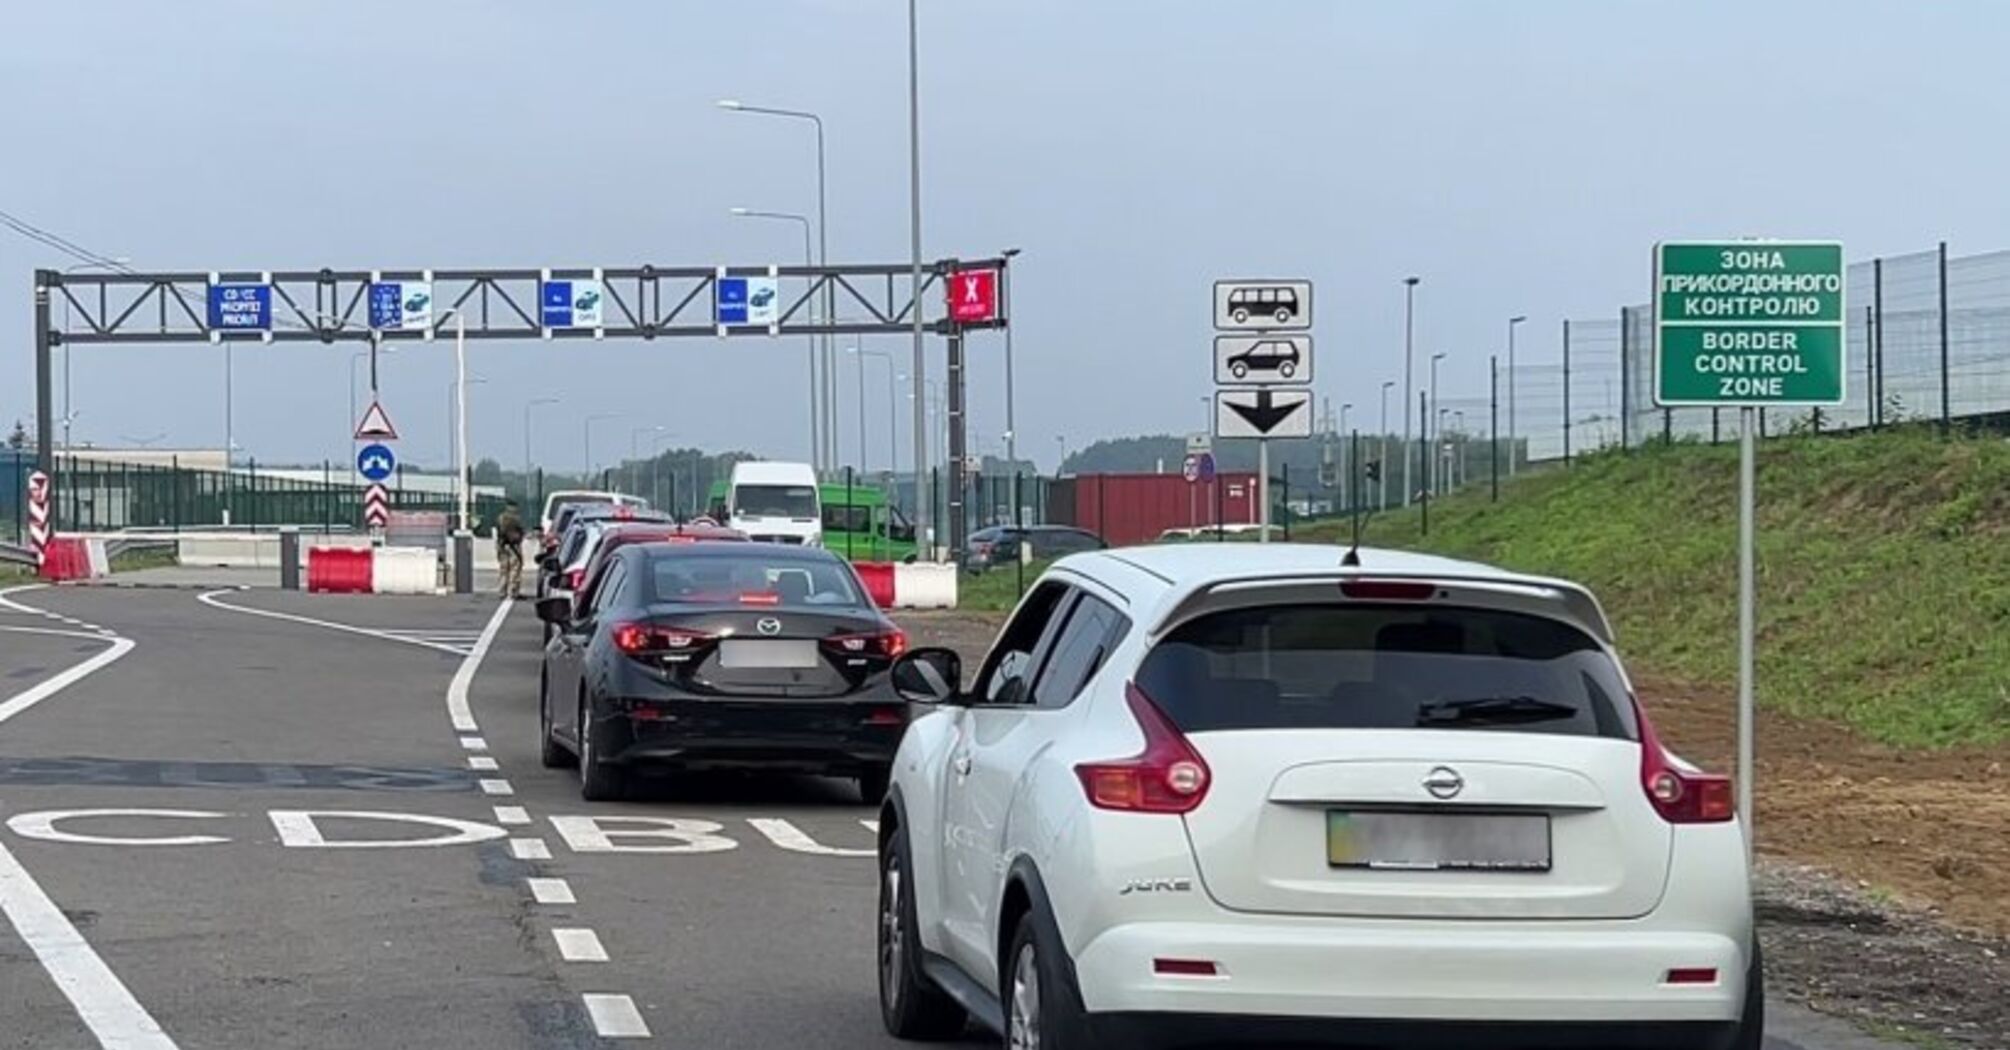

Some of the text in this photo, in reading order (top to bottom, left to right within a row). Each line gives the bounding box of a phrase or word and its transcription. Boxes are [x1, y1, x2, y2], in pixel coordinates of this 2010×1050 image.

[1720, 251, 1785, 268] ЗОНА
[1661, 274, 1840, 294] ПРИКОРДОННОГО
[1685, 297, 1820, 315] КОНТРОЛЮ
[1702, 332, 1798, 350] BORDER
[1695, 355, 1808, 373] CONTROL
[1720, 378, 1784, 396] ZONE
